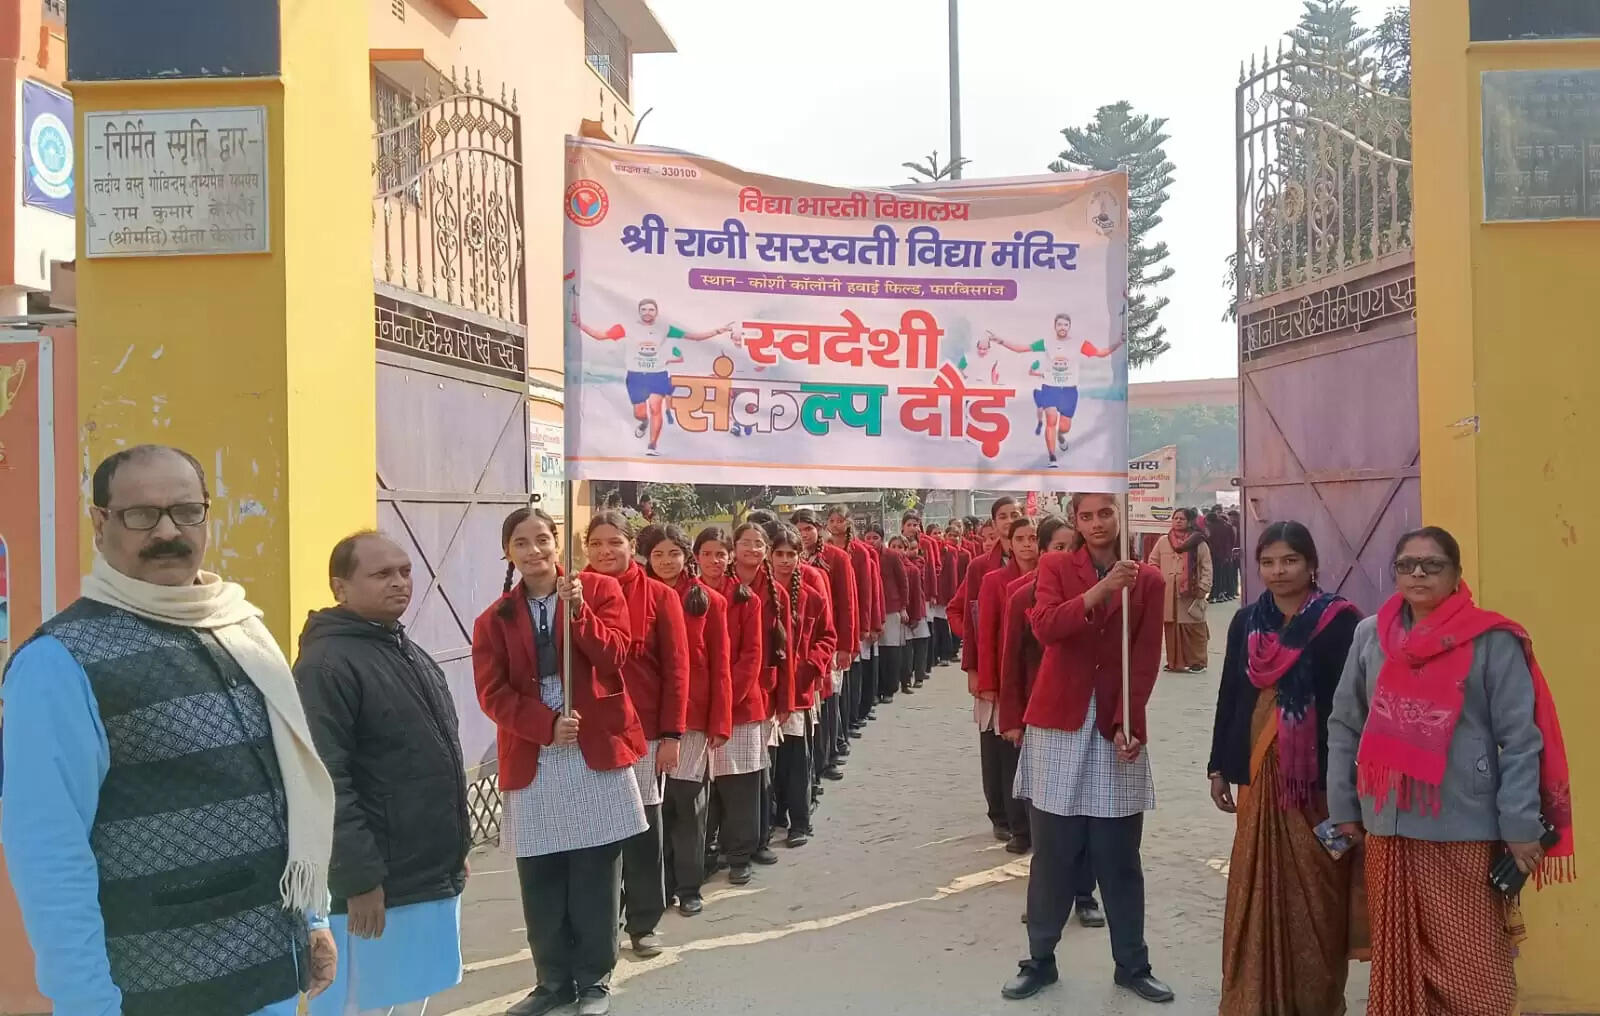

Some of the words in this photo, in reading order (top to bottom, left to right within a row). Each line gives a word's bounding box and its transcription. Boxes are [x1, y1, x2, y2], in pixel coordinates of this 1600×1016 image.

[165, 118, 209, 166] स्मृति
[125, 177, 144, 199] वस्तु
[148, 171, 188, 196] गोविन्दम्
[661, 166, 697, 178] 330100
[112, 207, 138, 221] राम
[151, 205, 194, 223] कुमार
[738, 186, 793, 214] विद्या
[797, 191, 869, 218] भारती
[873, 193, 970, 221] विद्यालय
[171, 225, 205, 244] सीता
[620, 213, 669, 255] श्री
[674, 218, 749, 259] रानी
[755, 224, 900, 266] सरस्वती
[905, 225, 986, 268] विद्या
[991, 230, 1080, 271] मंदिर
[748, 272, 786, 290] कोशी
[789, 276, 842, 292] कॉलौनी
[846, 278, 879, 296] हवाई
[930, 279, 1006, 297] फारबिसगंज
[742, 309, 945, 370] स्वदेशी
[670, 355, 889, 437] संकल्प
[897, 363, 1016, 458] दौड़
